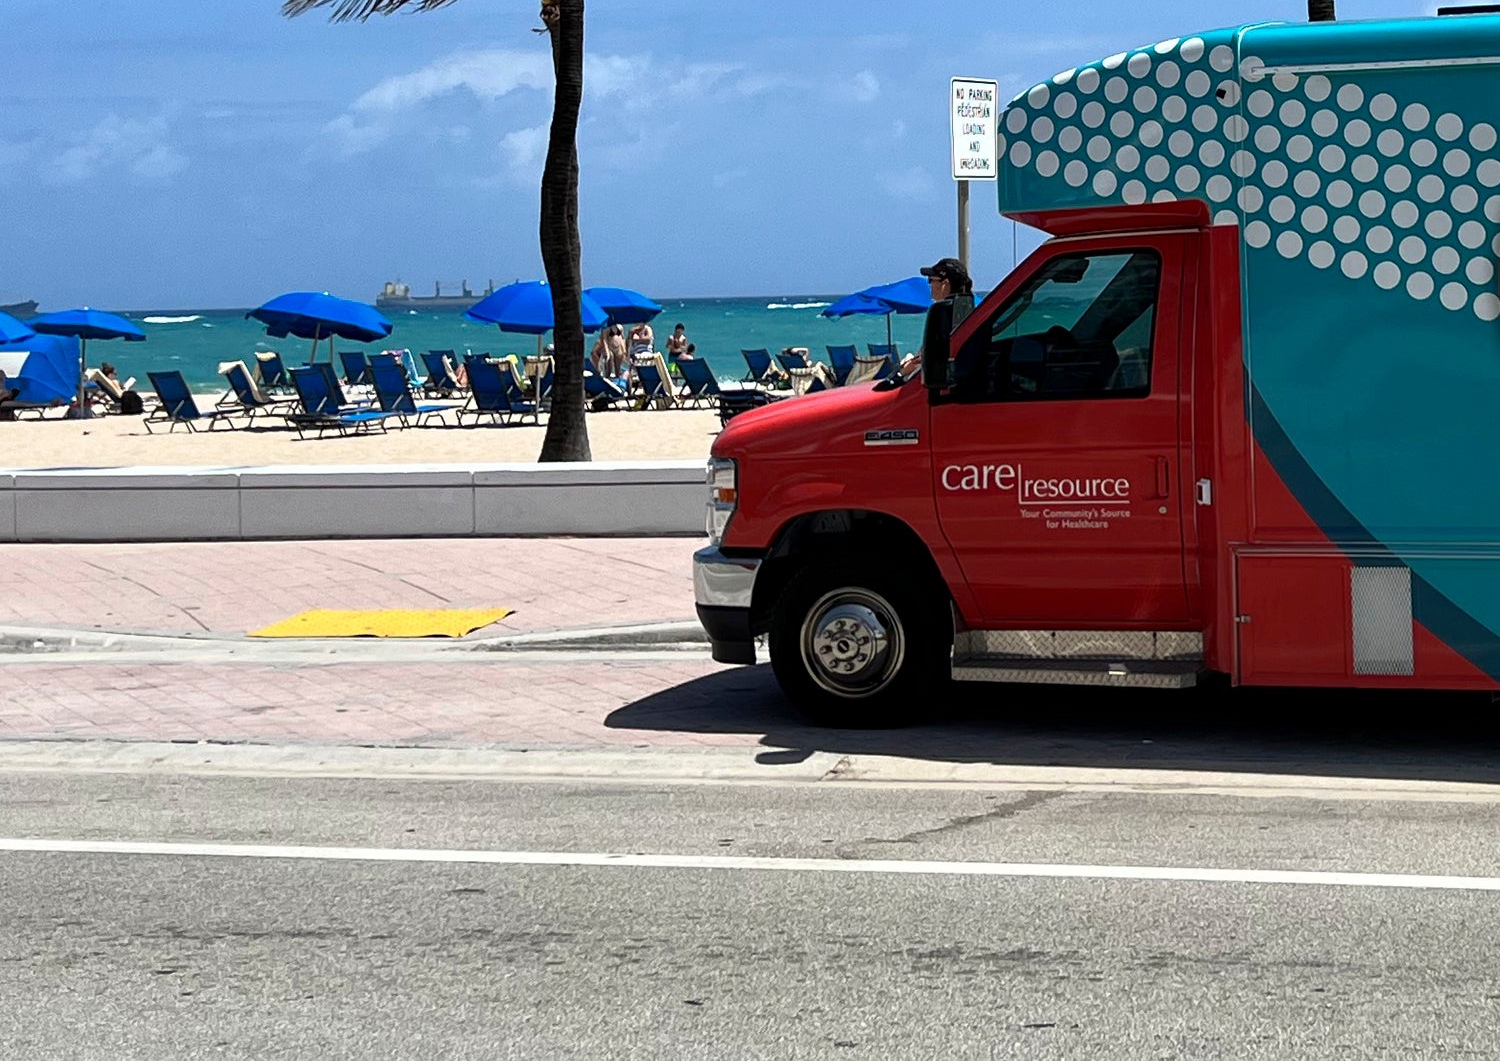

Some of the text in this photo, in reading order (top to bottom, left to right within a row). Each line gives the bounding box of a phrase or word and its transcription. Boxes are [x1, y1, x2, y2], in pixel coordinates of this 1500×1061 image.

[956, 88, 992, 101] NO PARKING
[963, 123, 986, 135] LOADING
[968, 141, 981, 152] AND
[941, 463, 1130, 498] care resource
[1020, 508, 1131, 519] Your Community's Source
[1046, 519, 1109, 528] for Healthcare
